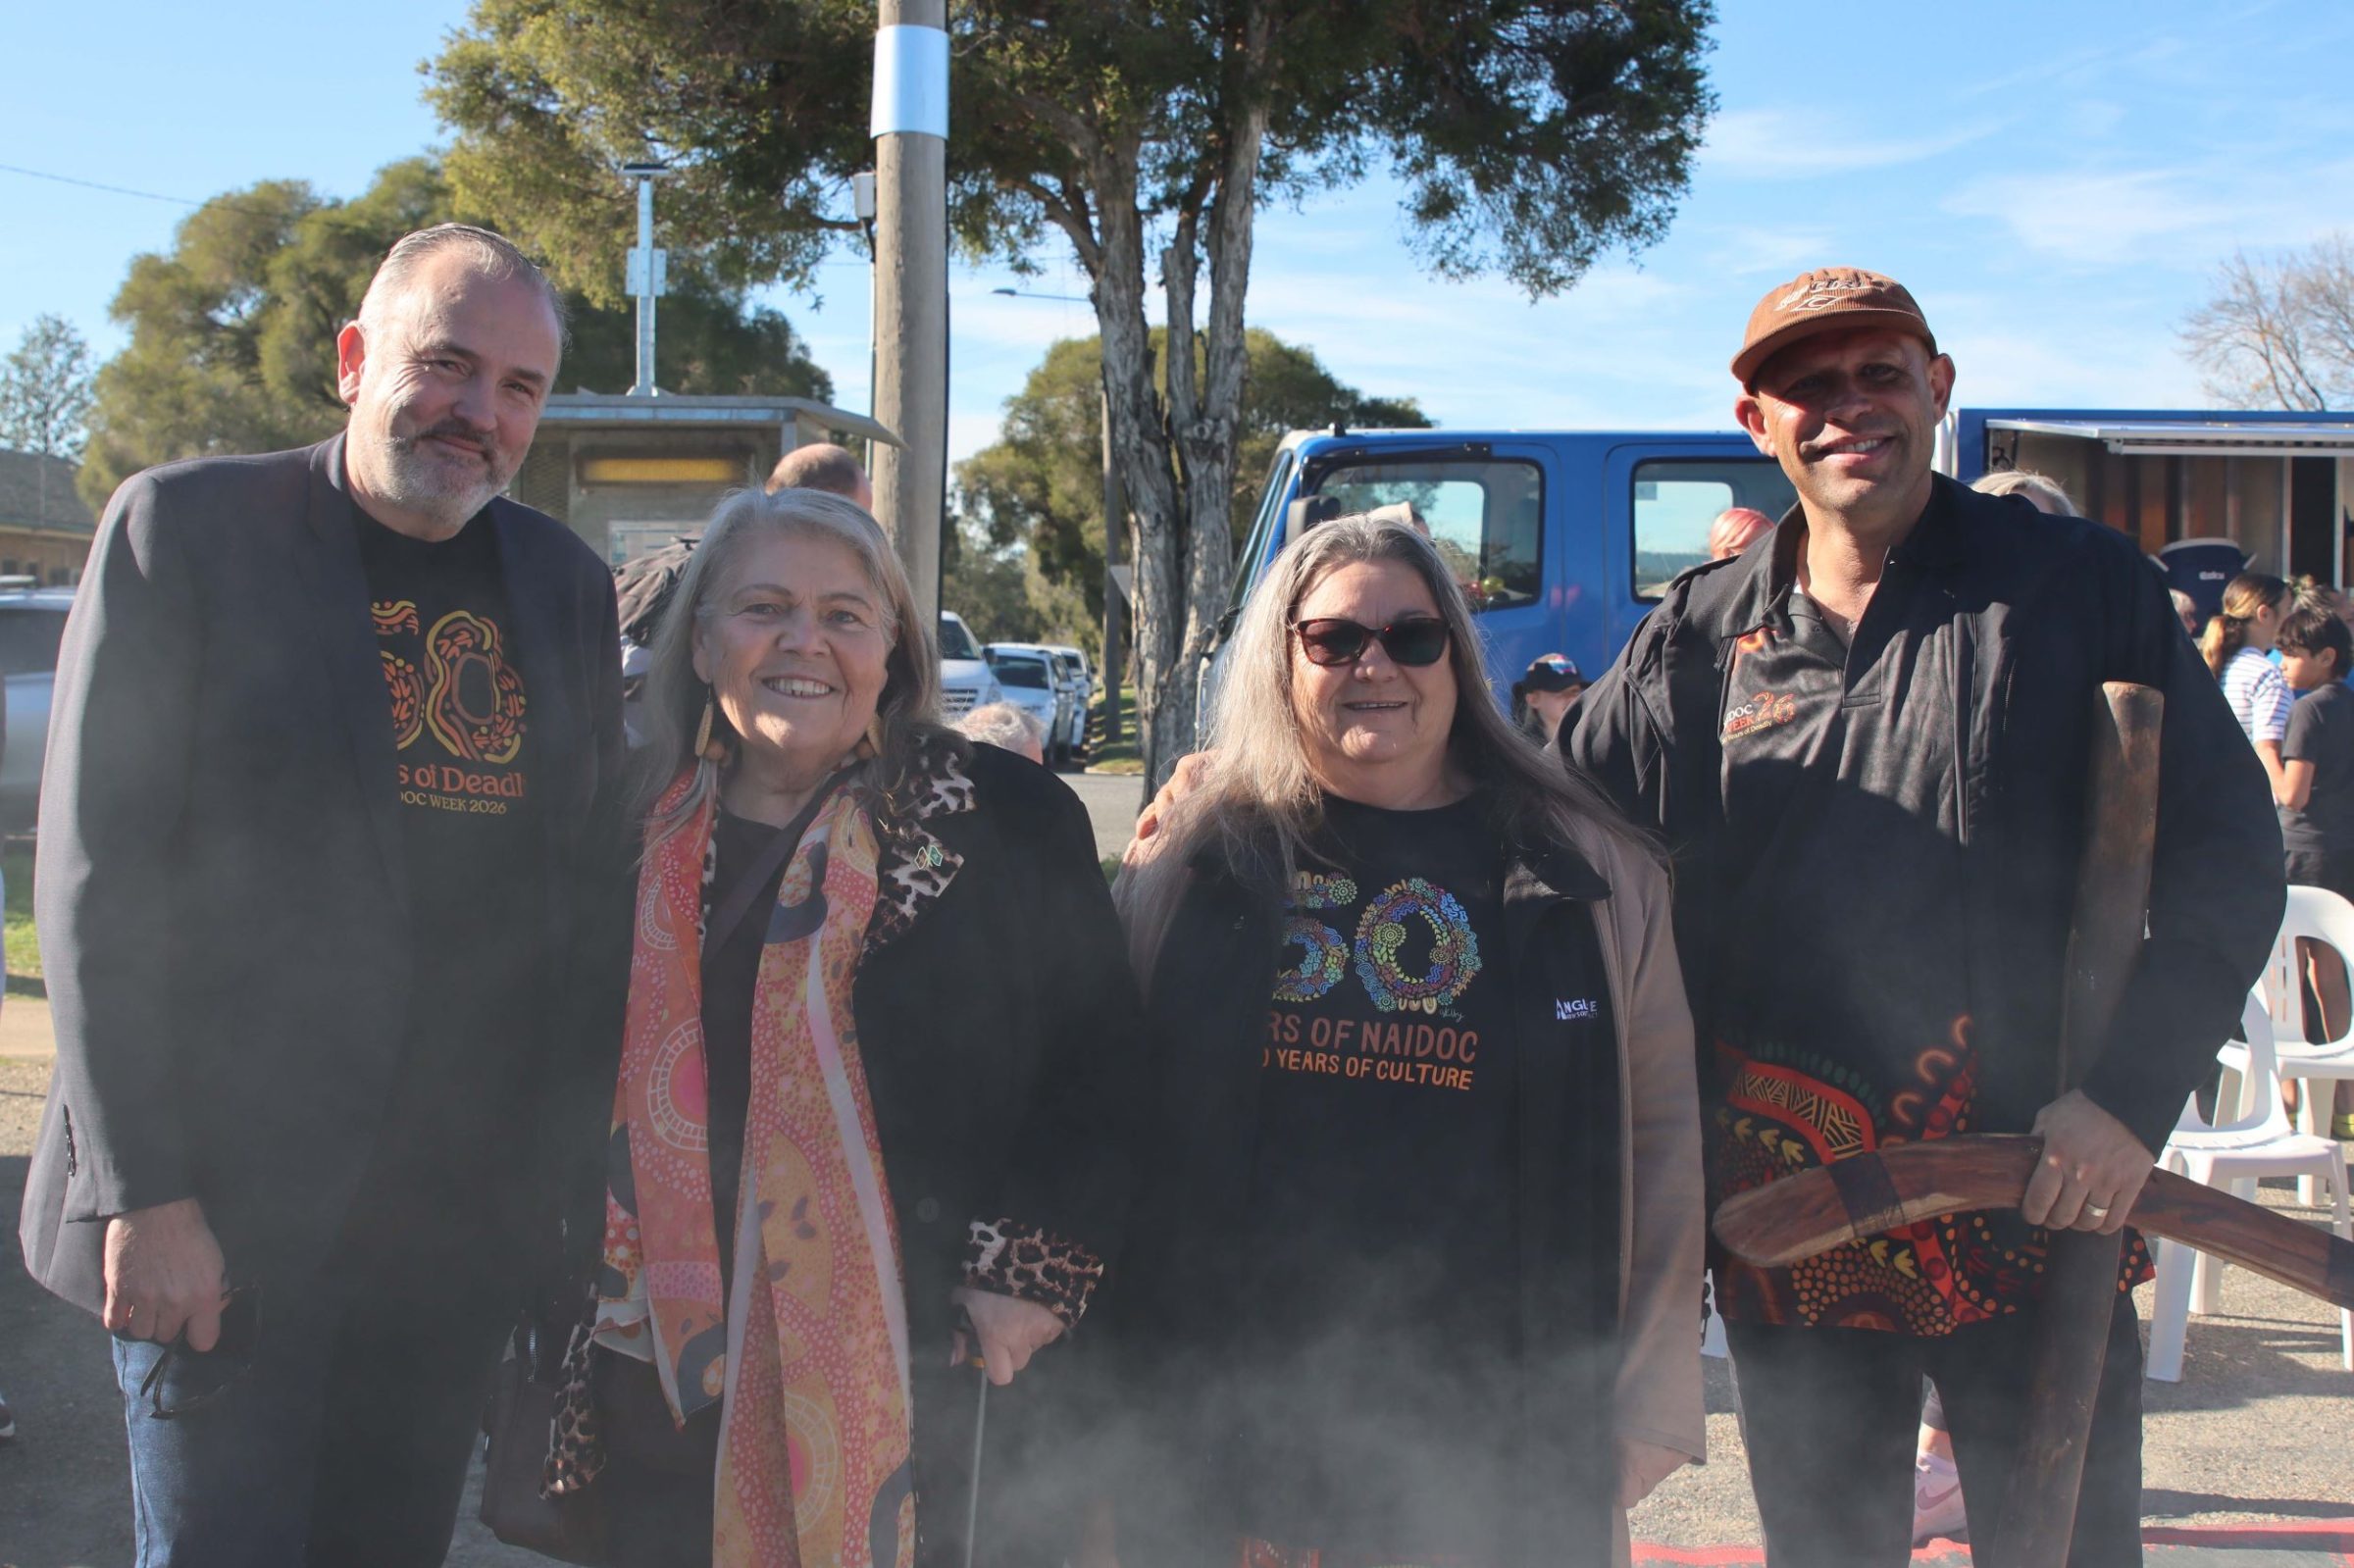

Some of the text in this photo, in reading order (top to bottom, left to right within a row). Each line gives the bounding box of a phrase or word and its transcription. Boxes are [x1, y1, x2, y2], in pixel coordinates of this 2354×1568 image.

[441, 766, 527, 799] Deadl
[430, 794, 467, 813] WEEK
[469, 799, 507, 816] 2026
[1310, 1017, 1356, 1049] OF
[1360, 1021, 1479, 1065] NAIDOC
[1276, 1048, 1340, 1075] YEARS
[1345, 1056, 1373, 1079] OF
[1376, 1060, 1473, 1090] CULTURE
